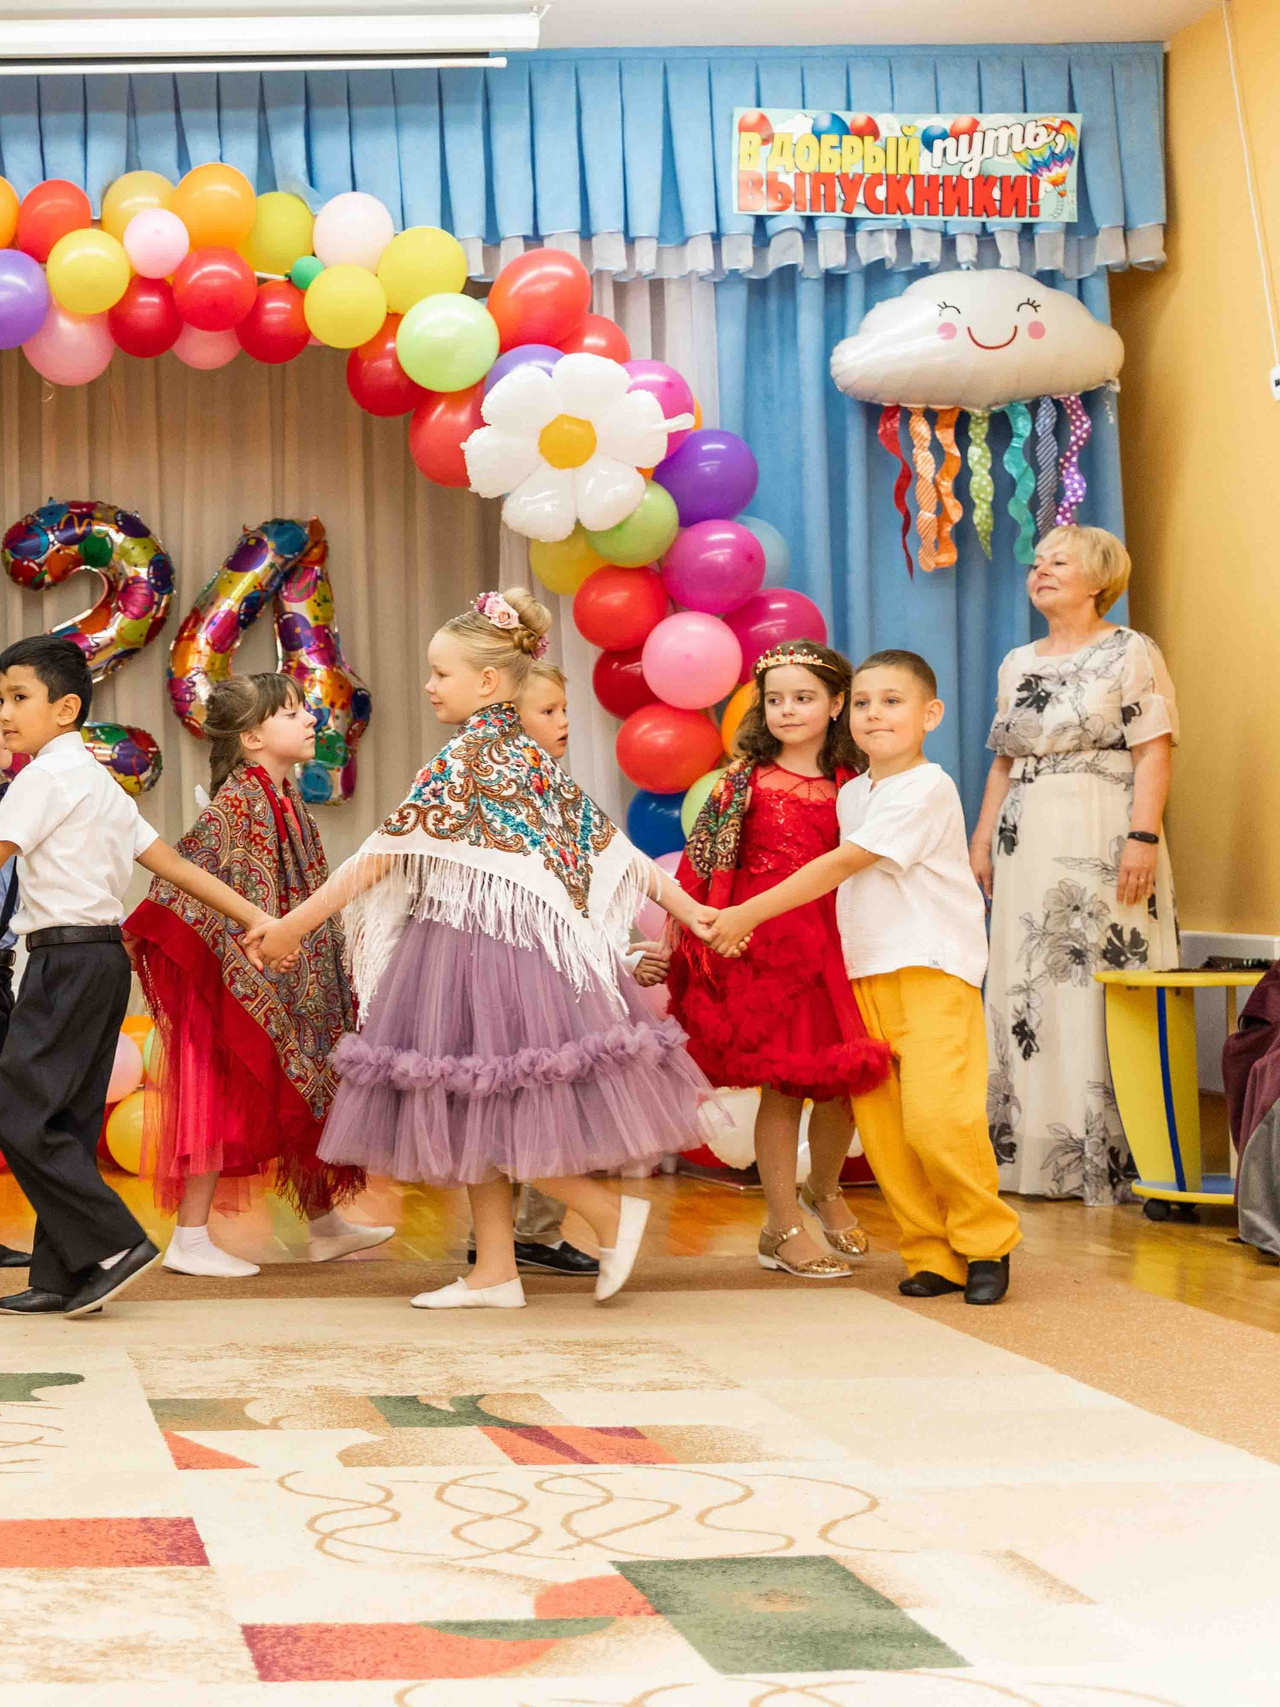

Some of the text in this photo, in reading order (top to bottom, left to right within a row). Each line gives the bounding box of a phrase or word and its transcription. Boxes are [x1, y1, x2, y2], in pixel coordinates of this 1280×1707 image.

[739, 119, 1066, 179] В ДОБРЫЙ путь,
[737, 170, 1041, 218] ВЫПУСКНИКИ!
